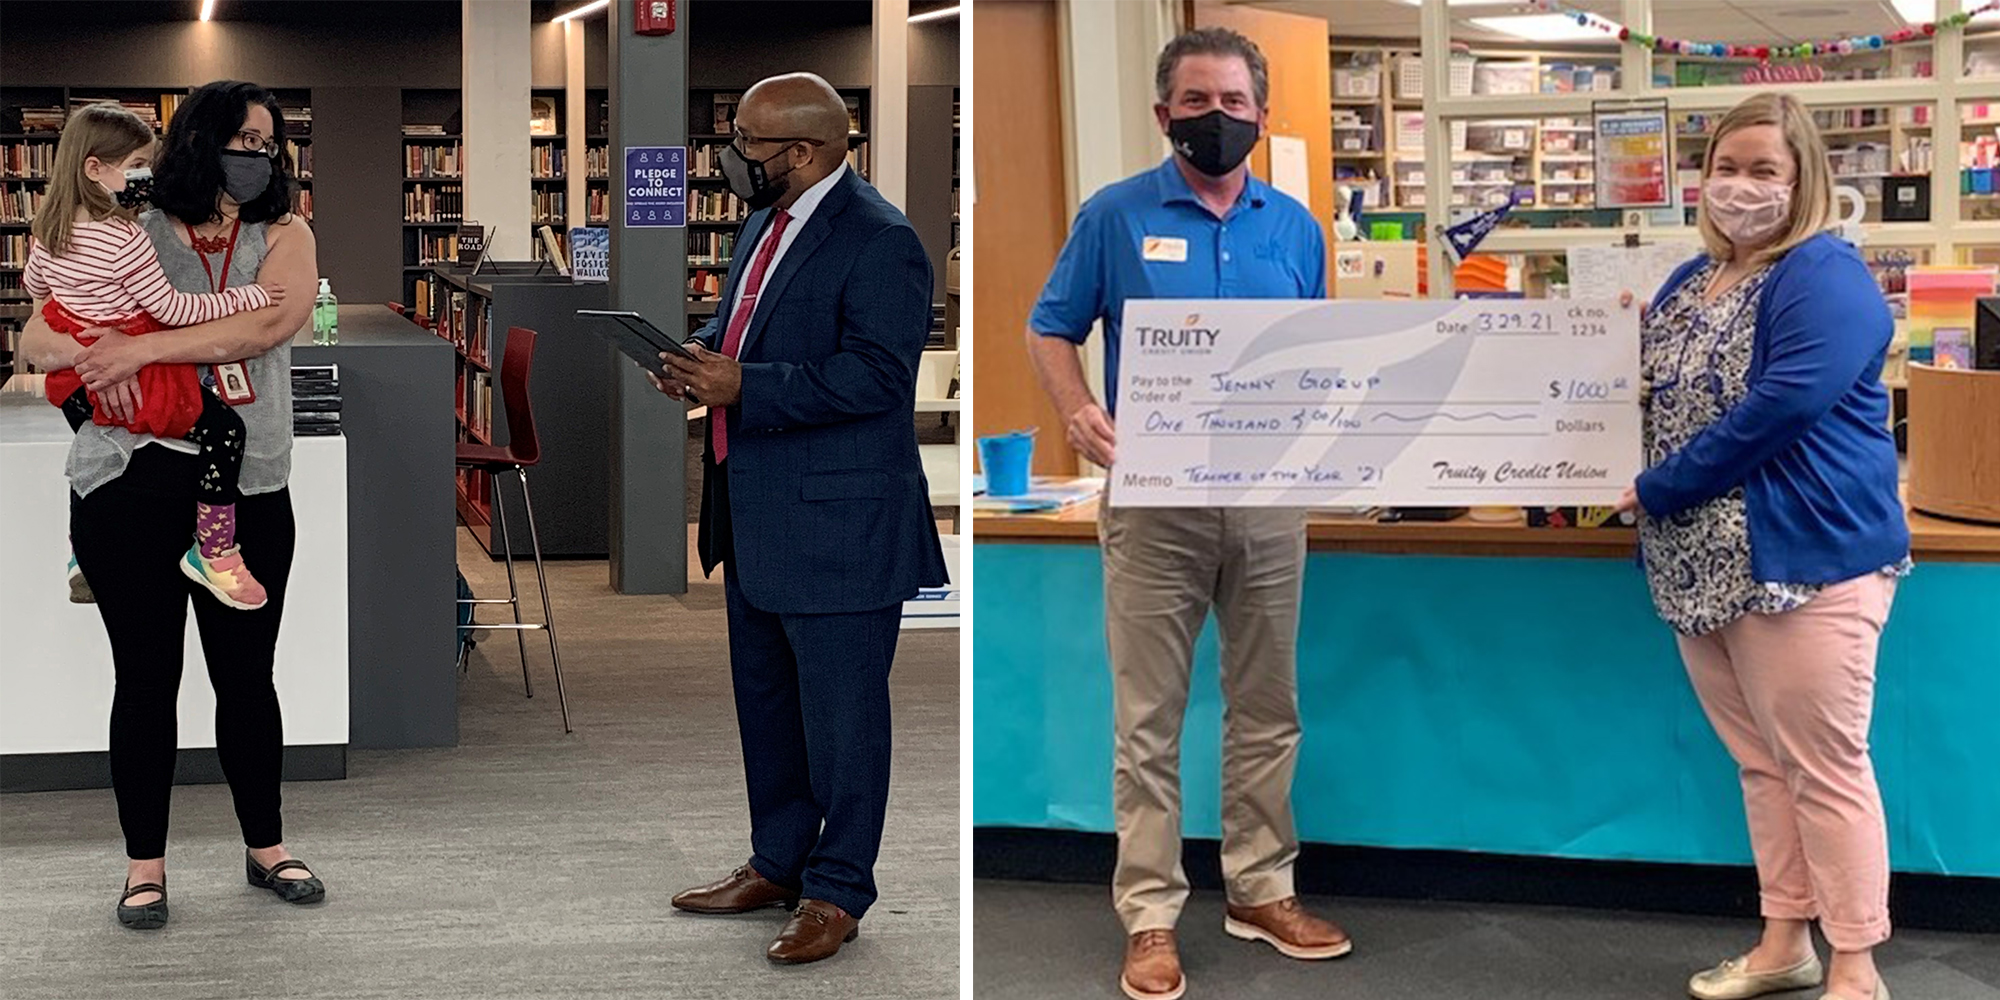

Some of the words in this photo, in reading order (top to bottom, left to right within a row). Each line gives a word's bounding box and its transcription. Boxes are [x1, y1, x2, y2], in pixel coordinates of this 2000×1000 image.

[634, 169, 677, 179] PLEDGE
[648, 178, 663, 188] TO
[628, 187, 682, 197] CONNECT
[461, 236, 480, 244] THE
[458, 243, 484, 251] ROAD
[575, 268, 609, 278] WALLAC
[1567, 306, 1584, 319] ck
[1586, 308, 1609, 319] no.
[1436, 320, 1469, 335] Date
[1571, 324, 1607, 336] 1234
[1135, 326, 1221, 347] TRUITY
[1131, 375, 1154, 388] Pay
[1156, 376, 1170, 387] to
[1171, 375, 1193, 387] the
[1129, 390, 1166, 403] Order
[1168, 390, 1182, 403] of
[1145, 410, 1184, 432] ONE
[1196, 409, 1281, 431] THOUSAND
[1555, 419, 1606, 432] Dollars
[1303, 465, 1343, 483] YEAR
[1432, 461, 1488, 484] Truity
[1494, 461, 1553, 484] Credit
[1555, 461, 1609, 480] Union
[1122, 473, 1173, 488] Memo
